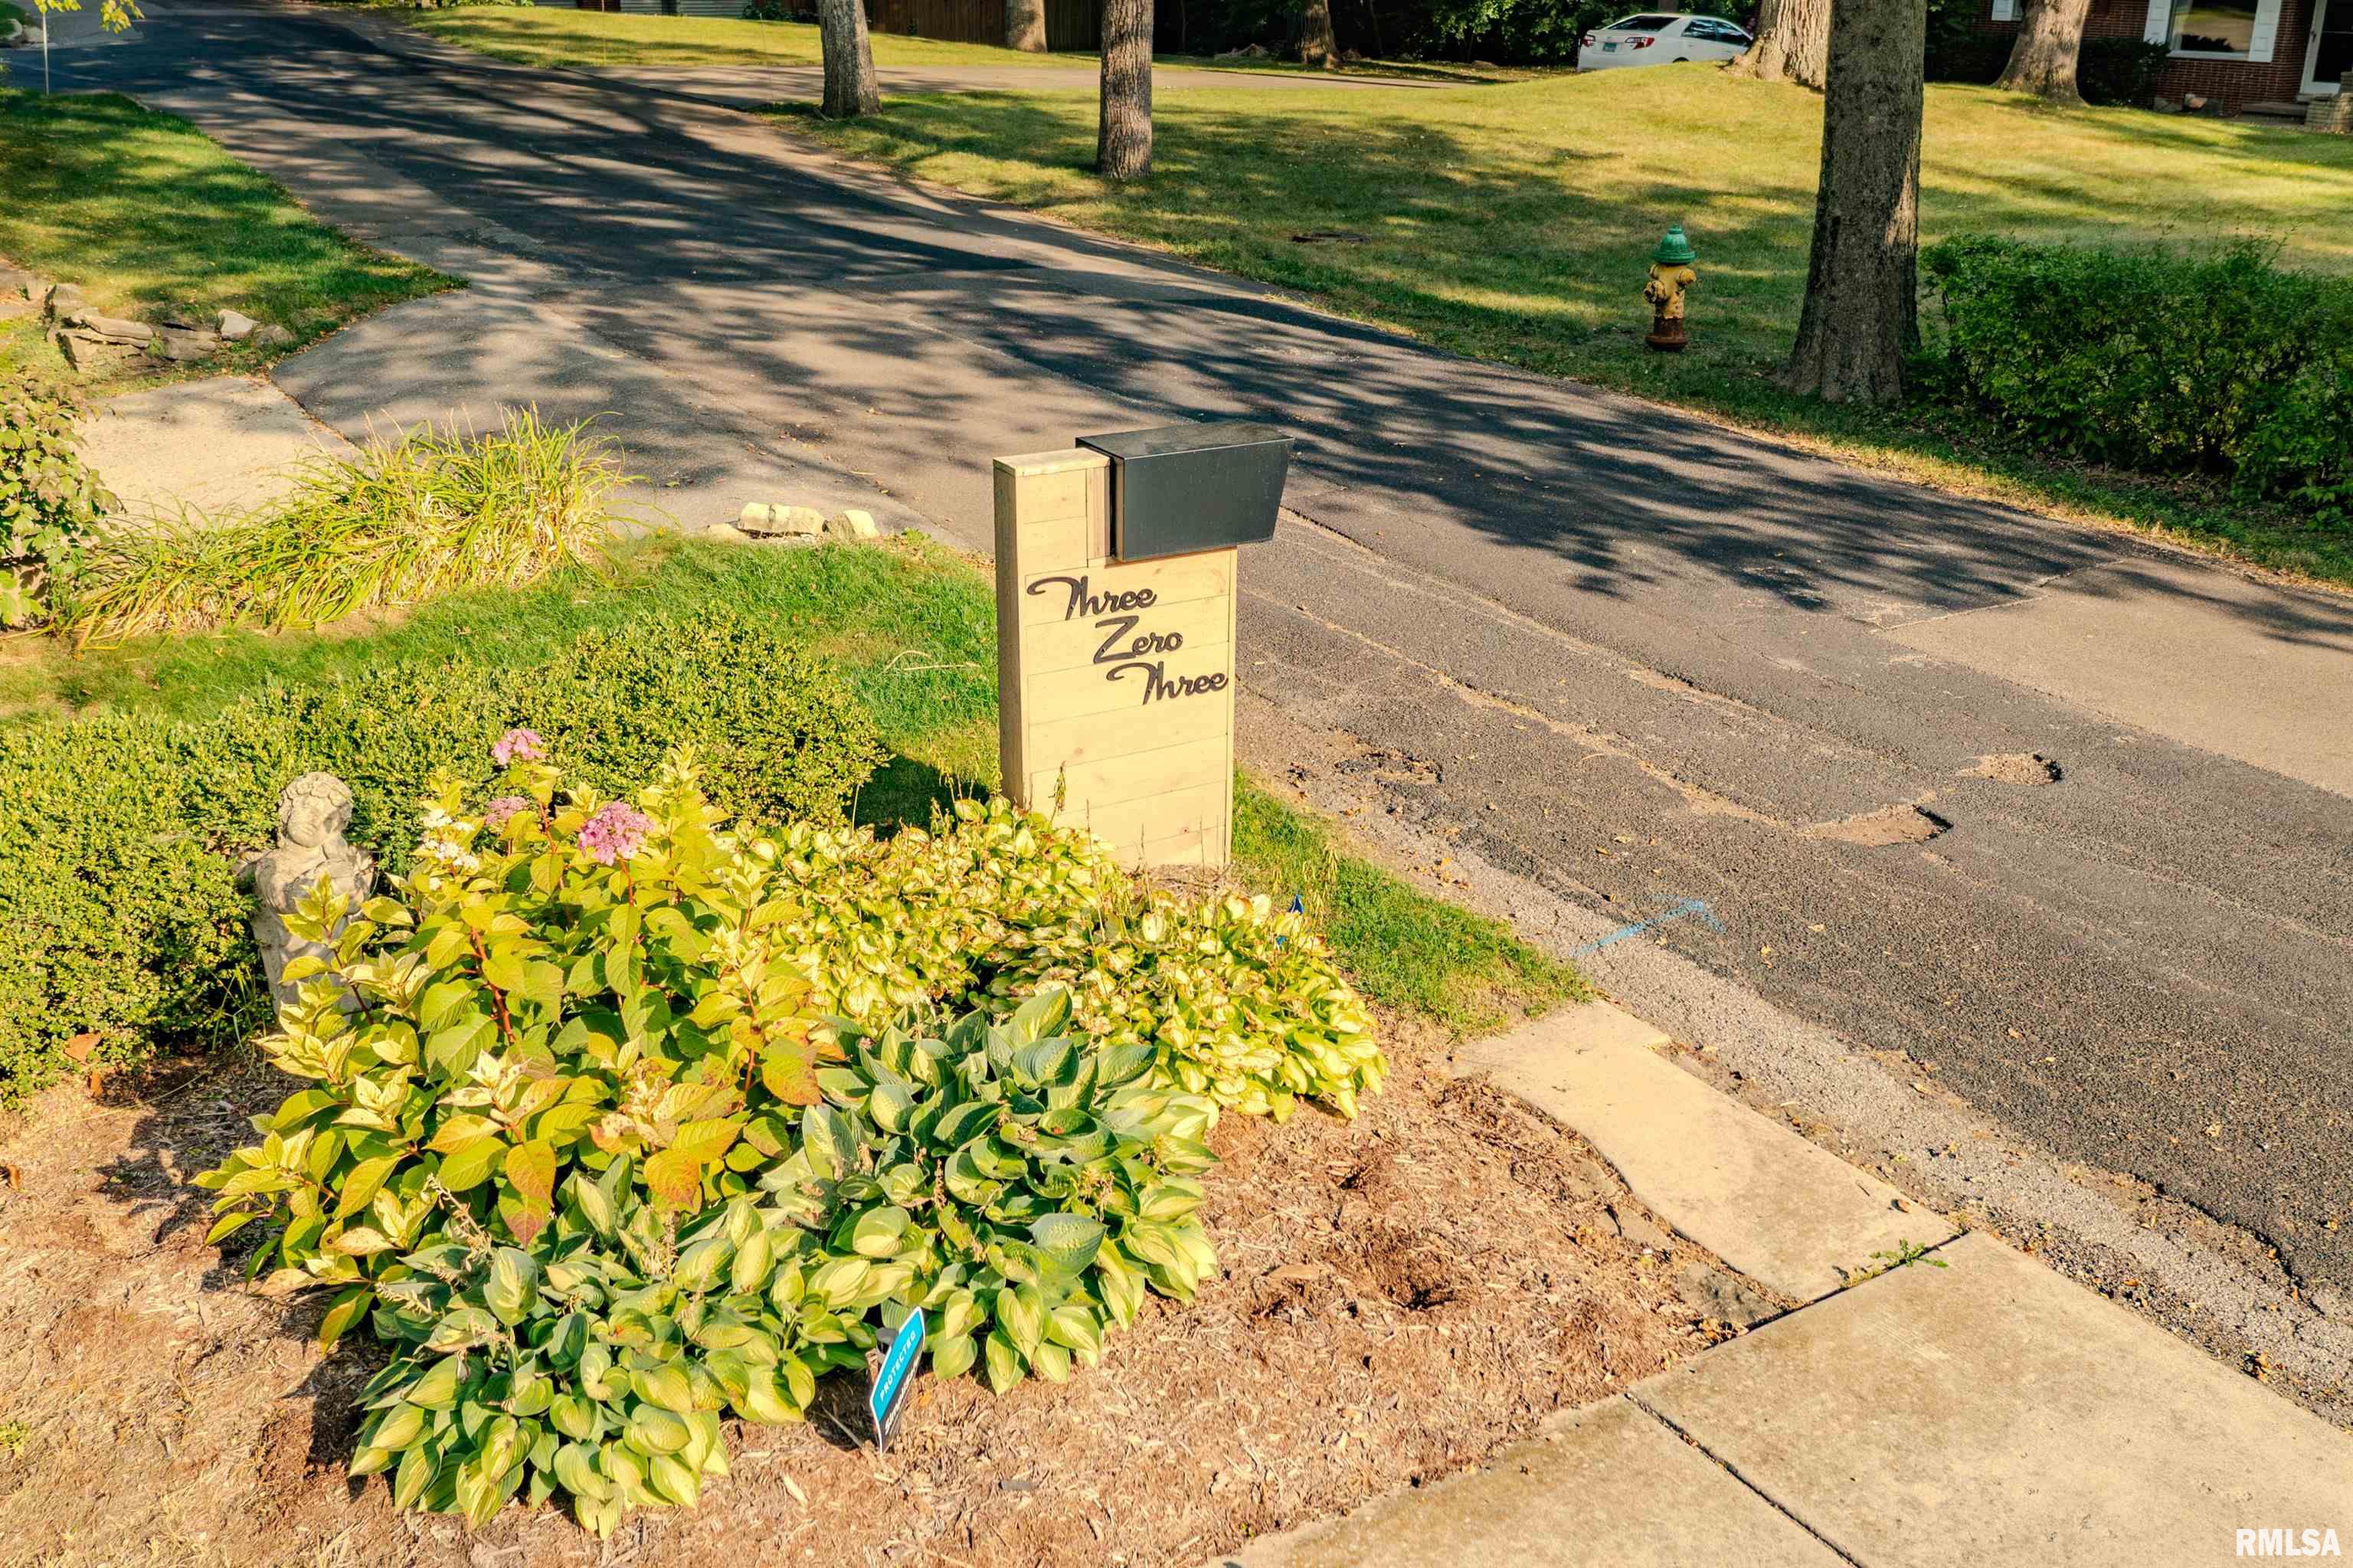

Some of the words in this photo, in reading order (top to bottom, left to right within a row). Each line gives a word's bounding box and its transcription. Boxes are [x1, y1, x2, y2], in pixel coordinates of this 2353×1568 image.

[1027, 575, 1157, 620] Three
[1093, 615, 1183, 664] Zero
[1106, 661, 1229, 705] Three
[880, 1330, 916, 1402] PROTECTED
